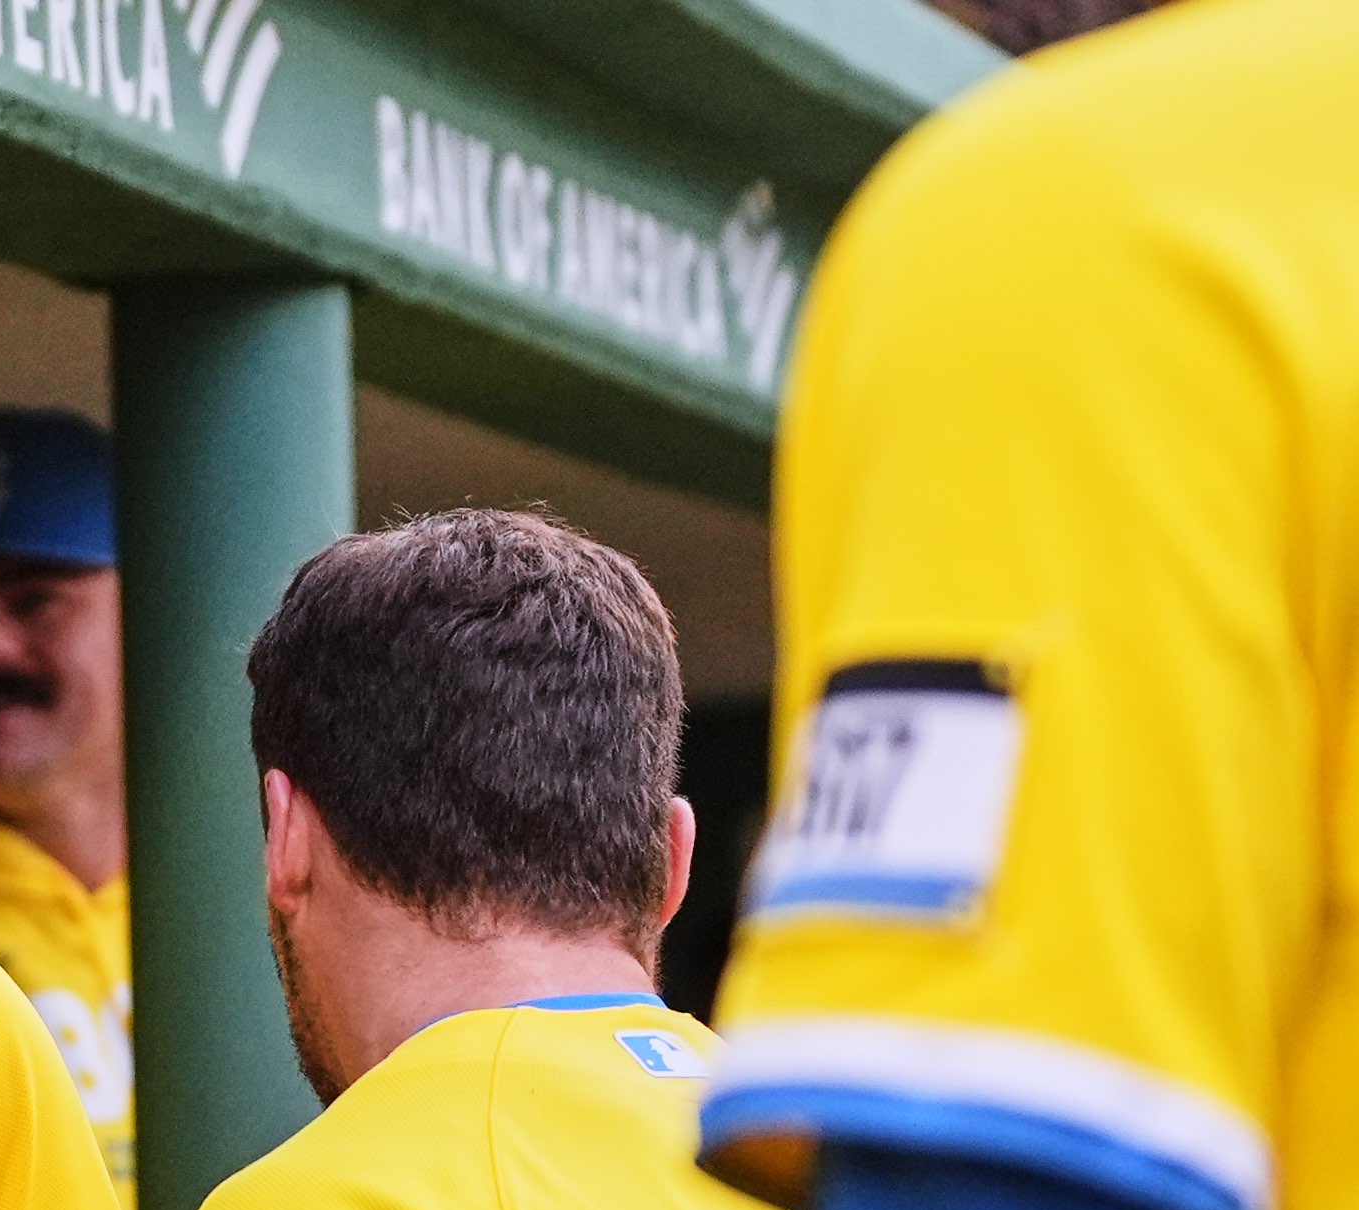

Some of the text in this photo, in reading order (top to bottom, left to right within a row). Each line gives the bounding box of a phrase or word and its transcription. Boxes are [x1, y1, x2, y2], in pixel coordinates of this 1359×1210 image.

[377, 94, 730, 361] BANK OF AMERICA
